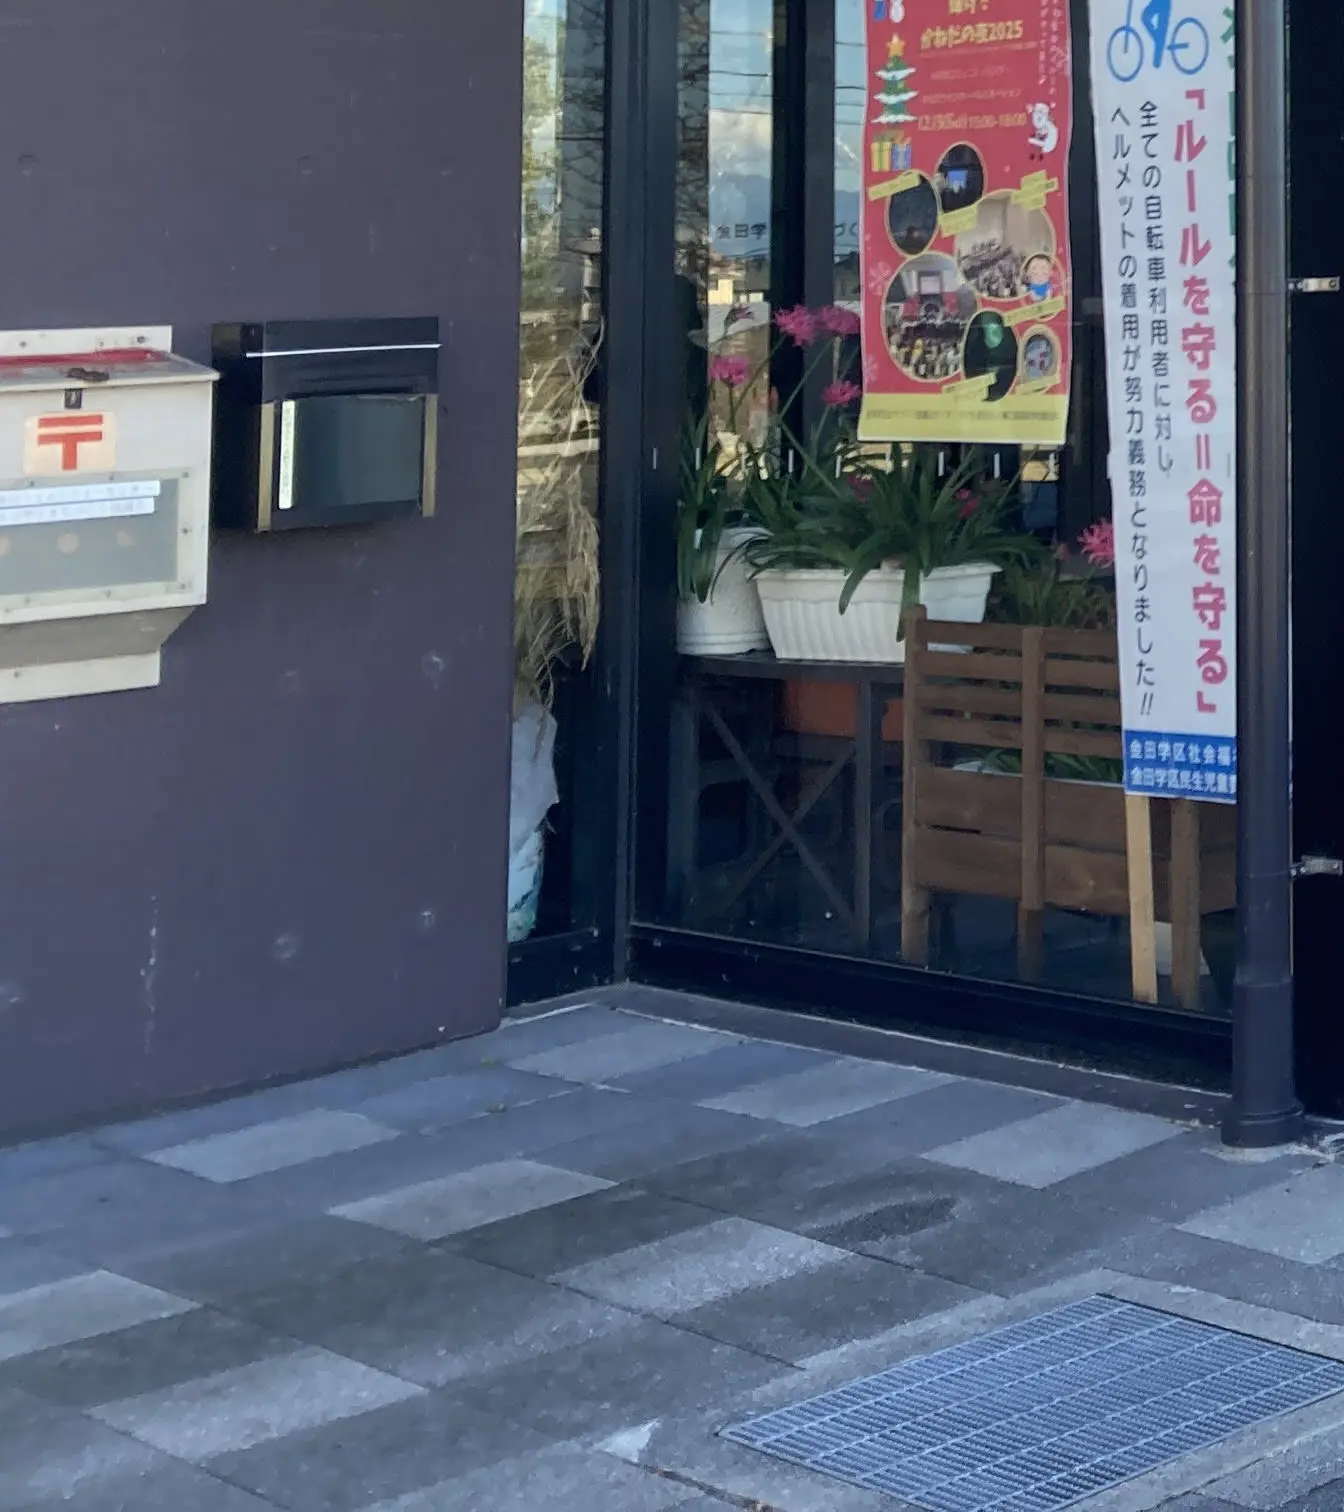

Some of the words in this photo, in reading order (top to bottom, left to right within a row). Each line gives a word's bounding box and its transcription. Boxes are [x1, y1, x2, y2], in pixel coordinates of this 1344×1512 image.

[1139, 99, 1174, 475] 全ての自転車利用者に対し
[1130, 738, 1236, 766] 金田学区社会福
